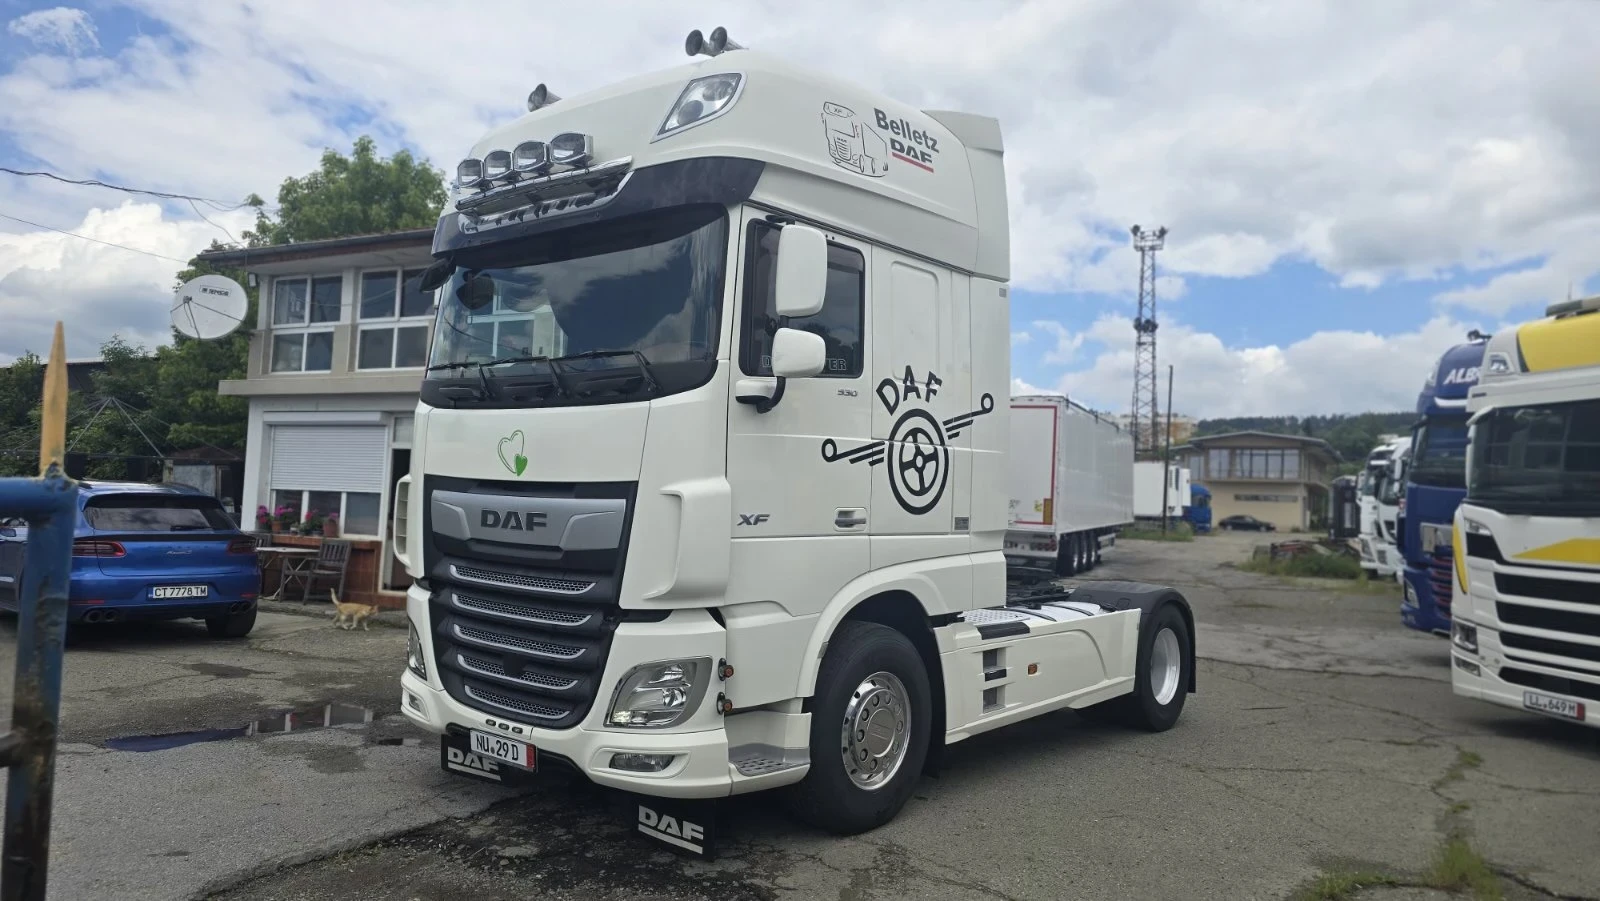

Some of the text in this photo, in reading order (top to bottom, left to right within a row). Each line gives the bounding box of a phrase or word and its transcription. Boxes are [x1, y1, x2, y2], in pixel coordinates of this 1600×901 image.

[874, 107, 939, 153] Belletz
[889, 138, 933, 164] DAF
[875, 365, 943, 416] DAF
[480, 509, 548, 531] DAF
[736, 513, 771, 526] XF
[155, 588, 168, 597] CT
[170, 587, 193, 597] 7778
[447, 746, 500, 772] DAF
[638, 805, 704, 840] DAF
